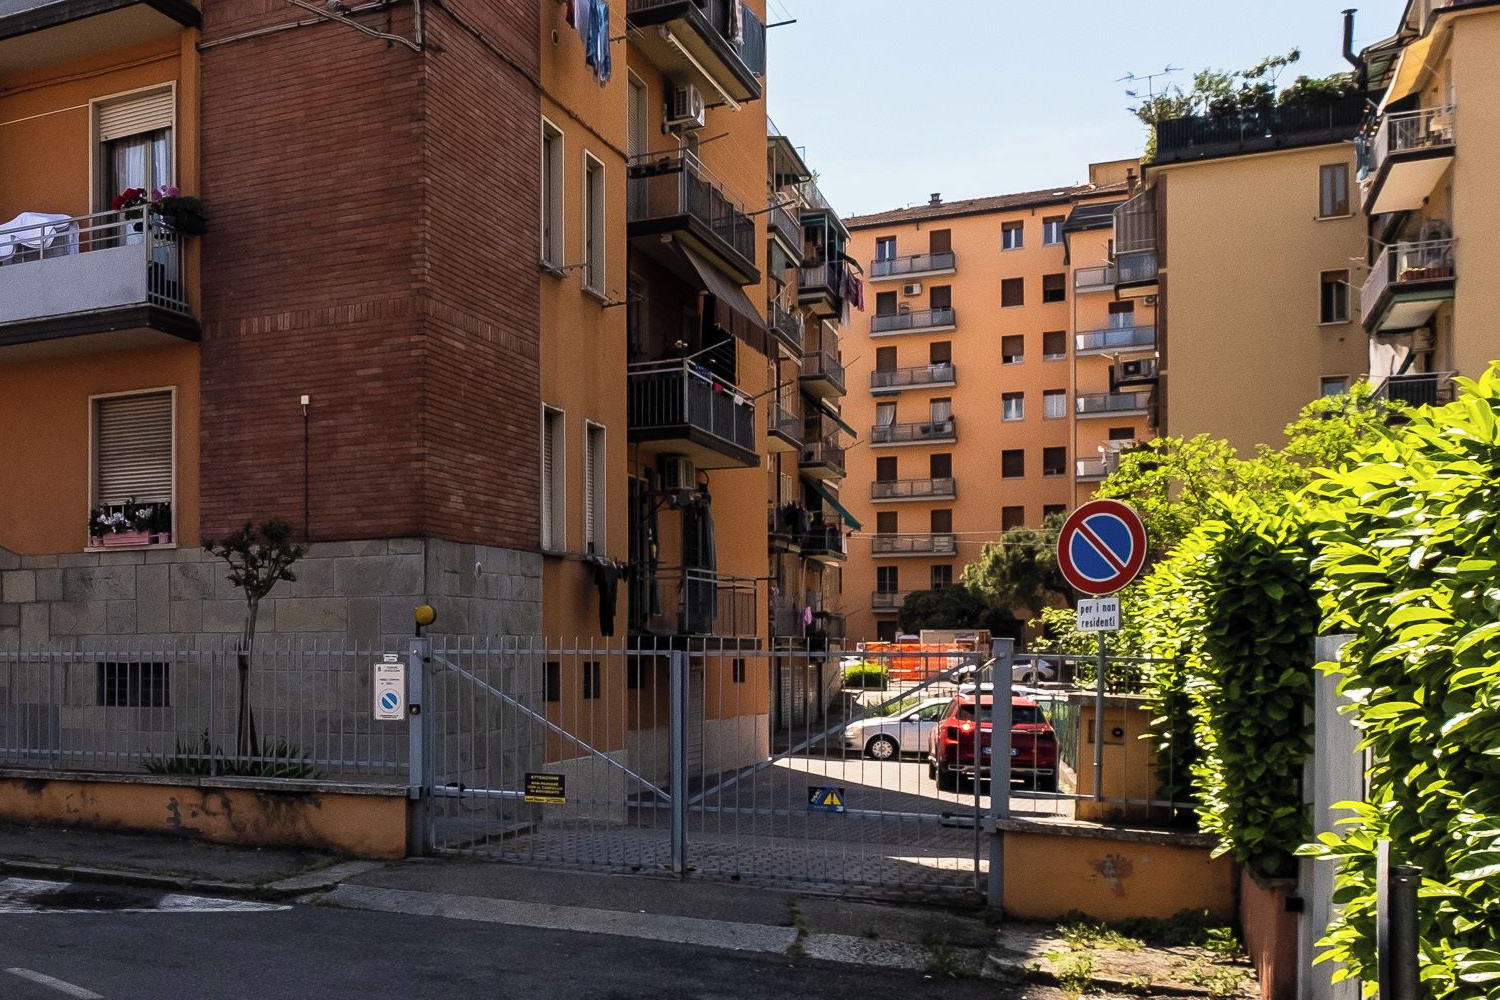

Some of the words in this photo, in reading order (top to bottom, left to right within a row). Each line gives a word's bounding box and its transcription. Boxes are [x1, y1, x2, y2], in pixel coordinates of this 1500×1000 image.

[1080, 606, 1092, 616] per
[1102, 604, 1116, 612] non
[1081, 616, 1116, 628] residenti
